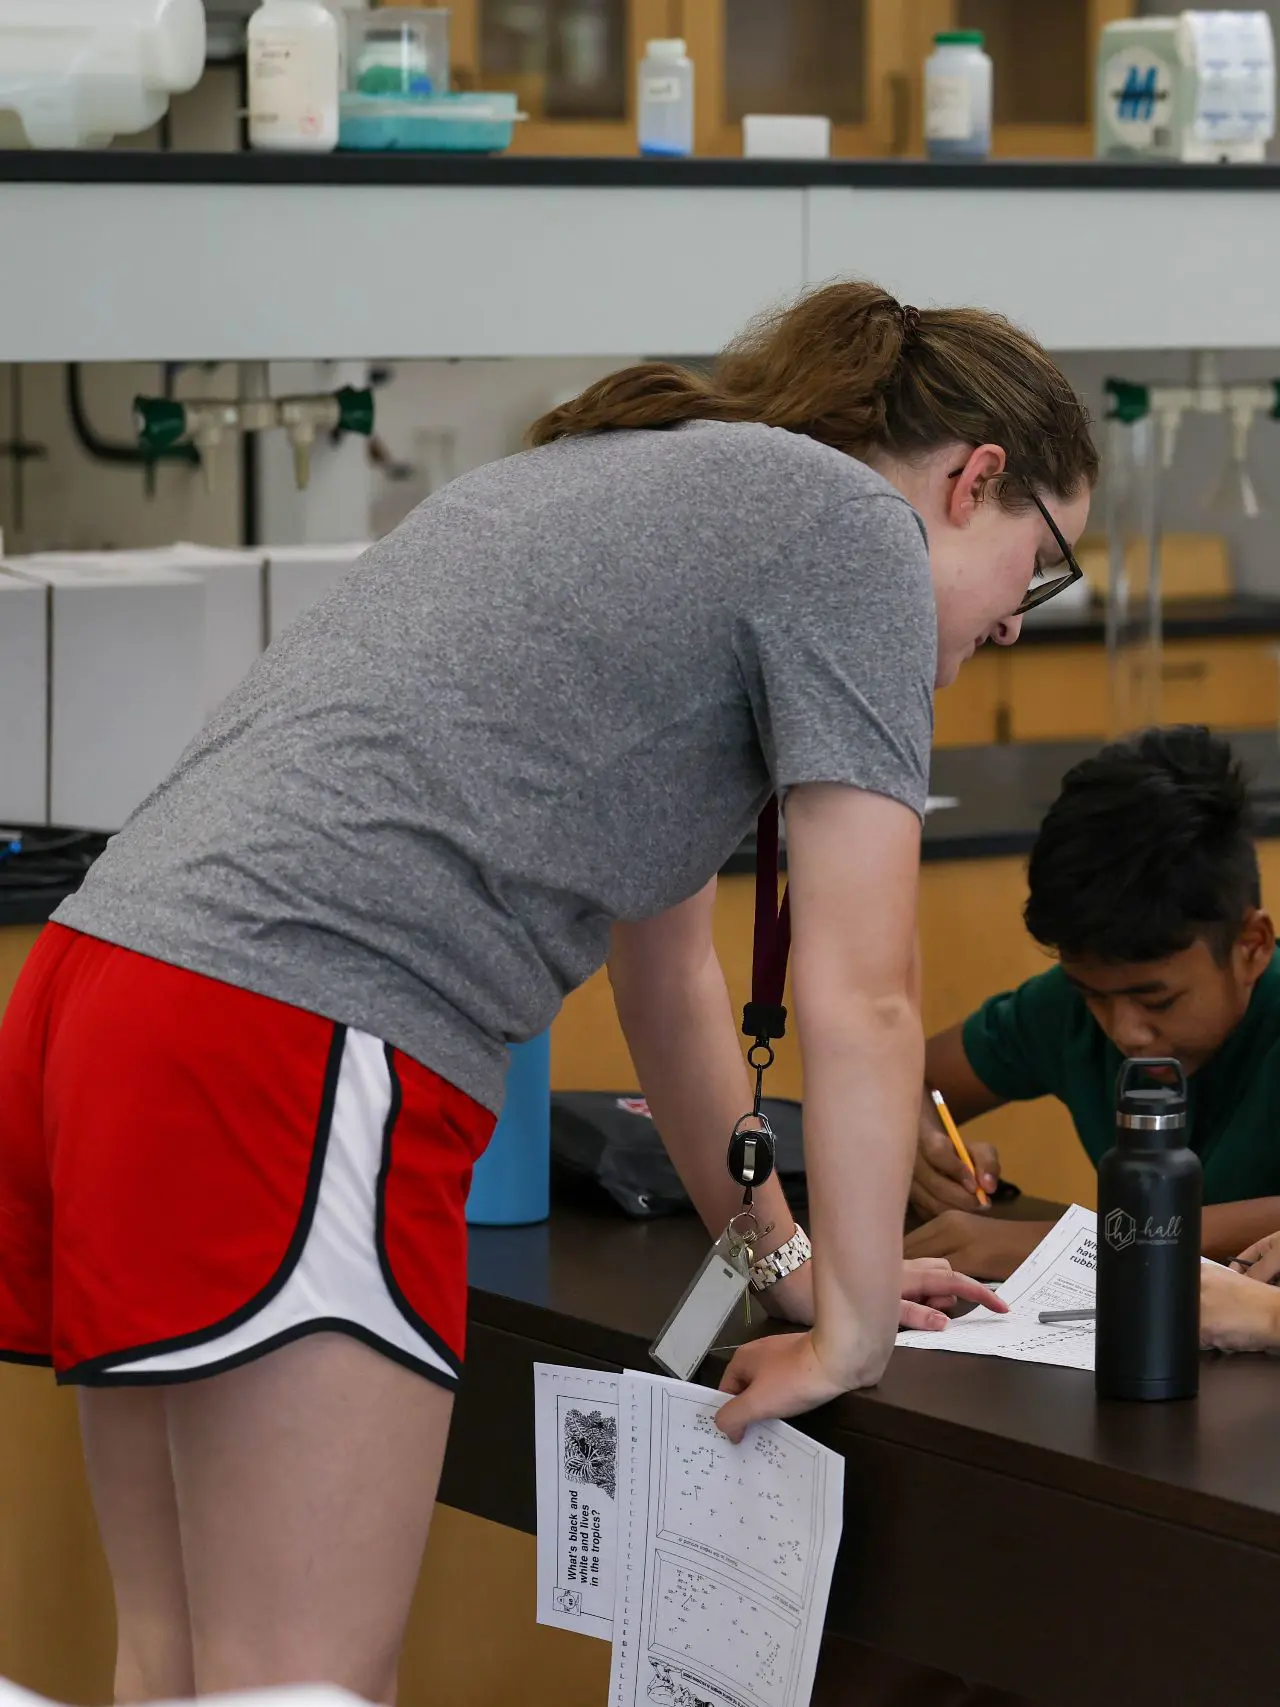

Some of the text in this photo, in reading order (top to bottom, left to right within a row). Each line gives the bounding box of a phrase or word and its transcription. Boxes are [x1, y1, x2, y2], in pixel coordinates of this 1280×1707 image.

[1083, 1238, 1098, 1251] Wh
[1141, 1215, 1182, 1238] hall
[1069, 1255, 1098, 1271] rubbis
[568, 1490, 578, 1580] What's black and
[579, 1504, 590, 1584] white and lives
[589, 1509, 602, 1587] in the tropics?
